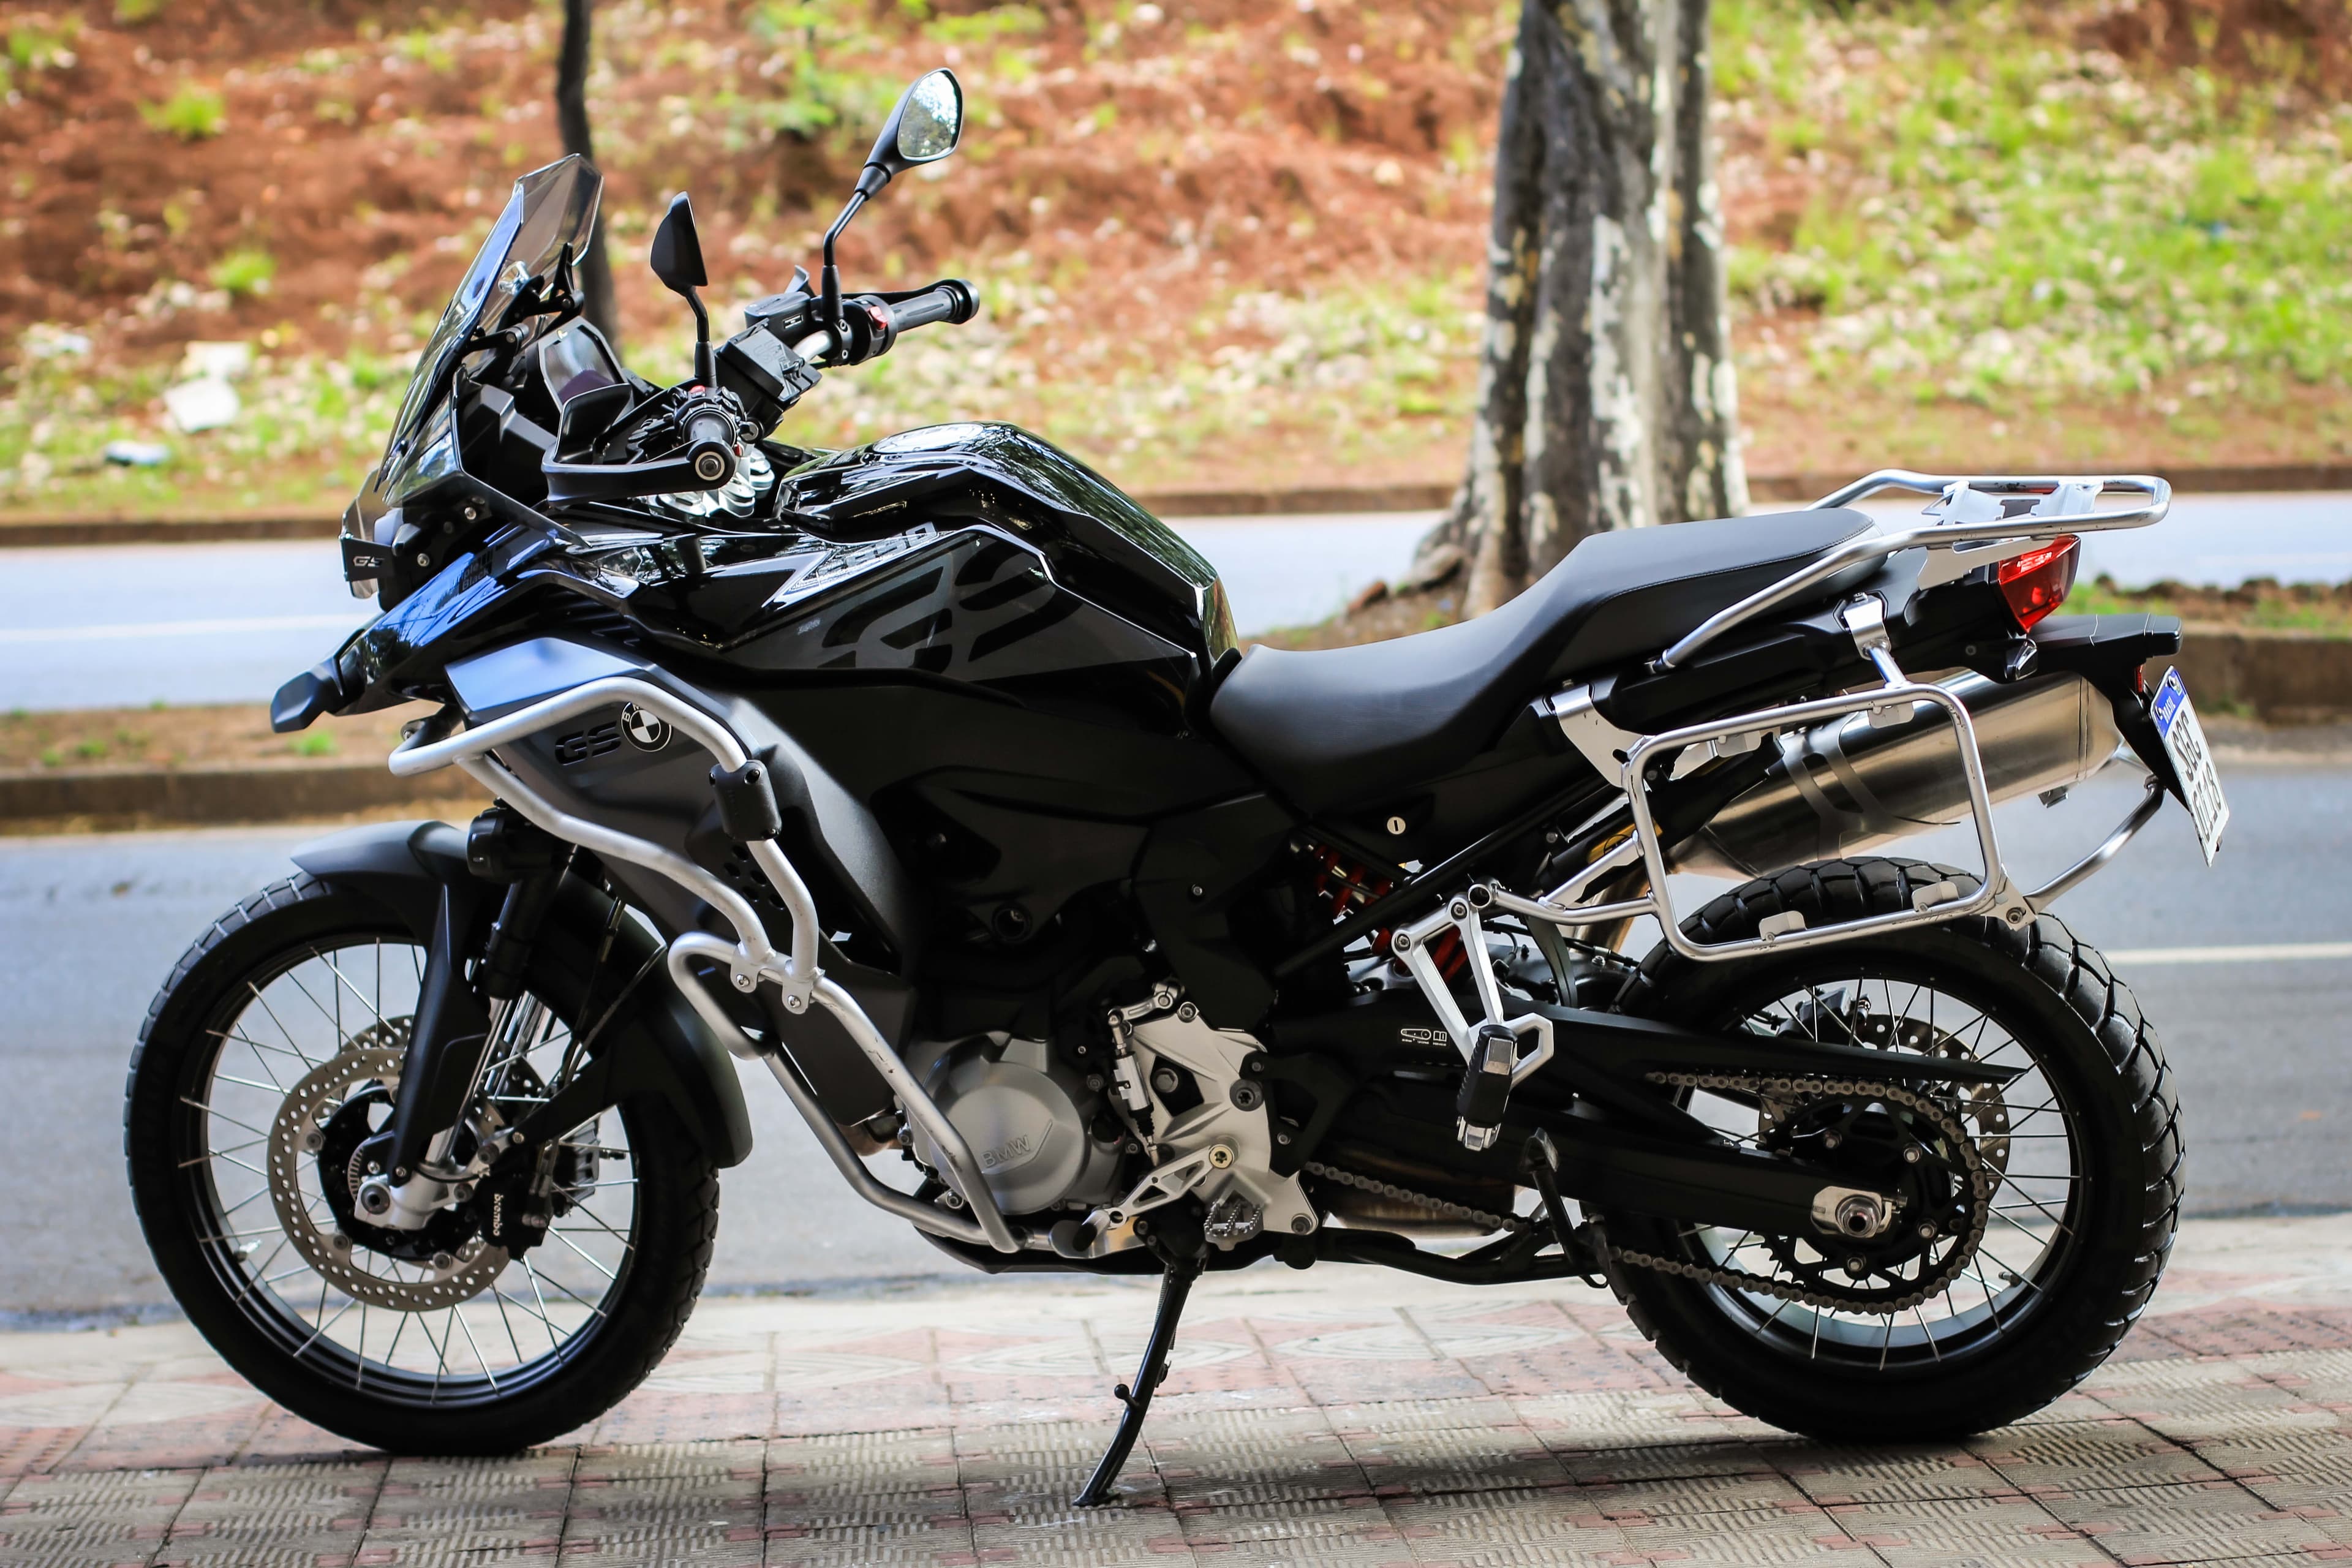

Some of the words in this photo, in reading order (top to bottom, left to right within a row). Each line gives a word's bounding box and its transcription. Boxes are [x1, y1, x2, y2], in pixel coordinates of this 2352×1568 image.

[352, 556, 385, 567] GS
[817, 537, 1083, 674] GS
[555, 720, 621, 766] GS
[981, 1135, 1030, 1168] BMW
[493, 1194, 503, 1236] brembo
